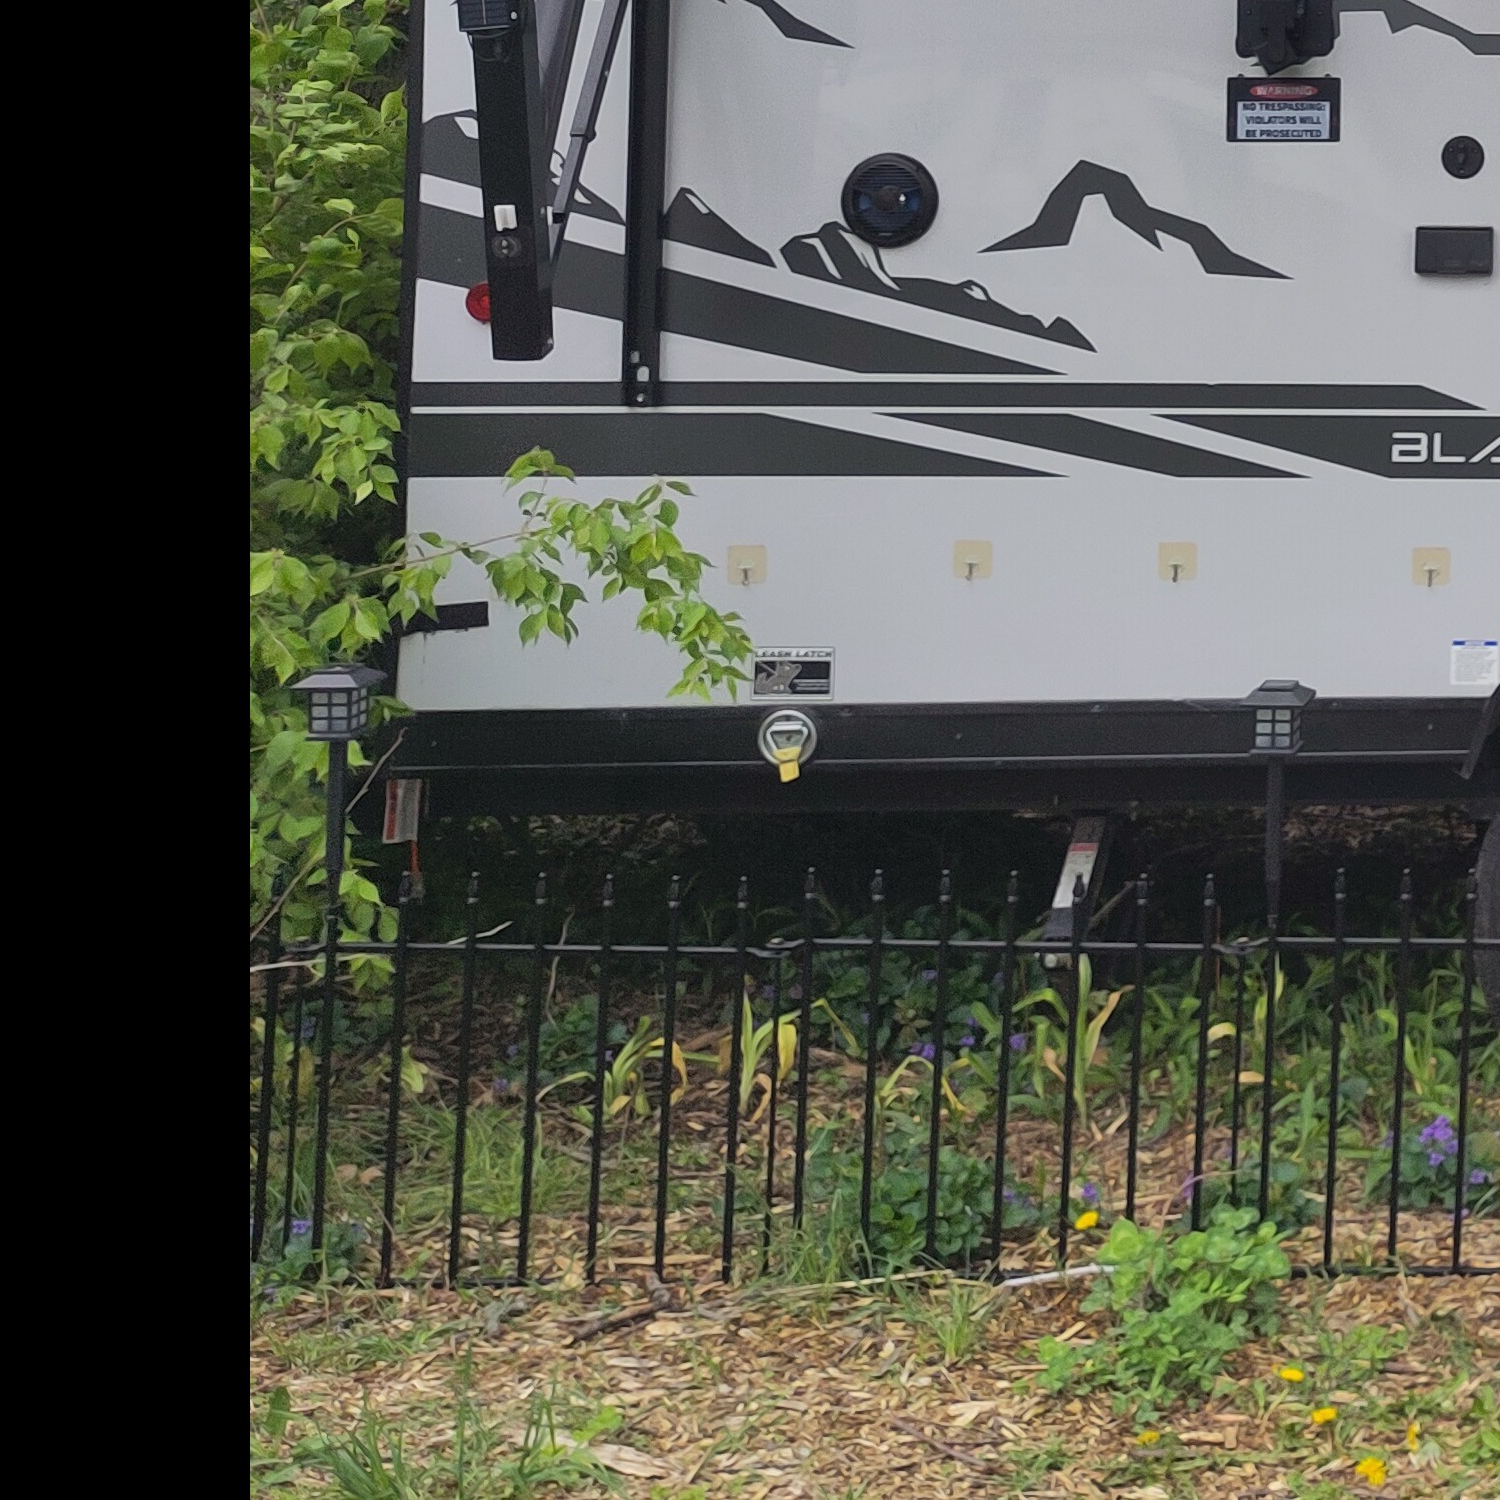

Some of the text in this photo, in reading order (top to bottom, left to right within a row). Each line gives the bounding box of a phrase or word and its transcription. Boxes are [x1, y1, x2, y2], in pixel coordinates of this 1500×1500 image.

[1242, 103, 1256, 111] NO
[1246, 116, 1322, 124] VIOLATORS WILL
[1246, 129, 1322, 138] BE PROSECUTED
[796, 650, 832, 658] LATCH
